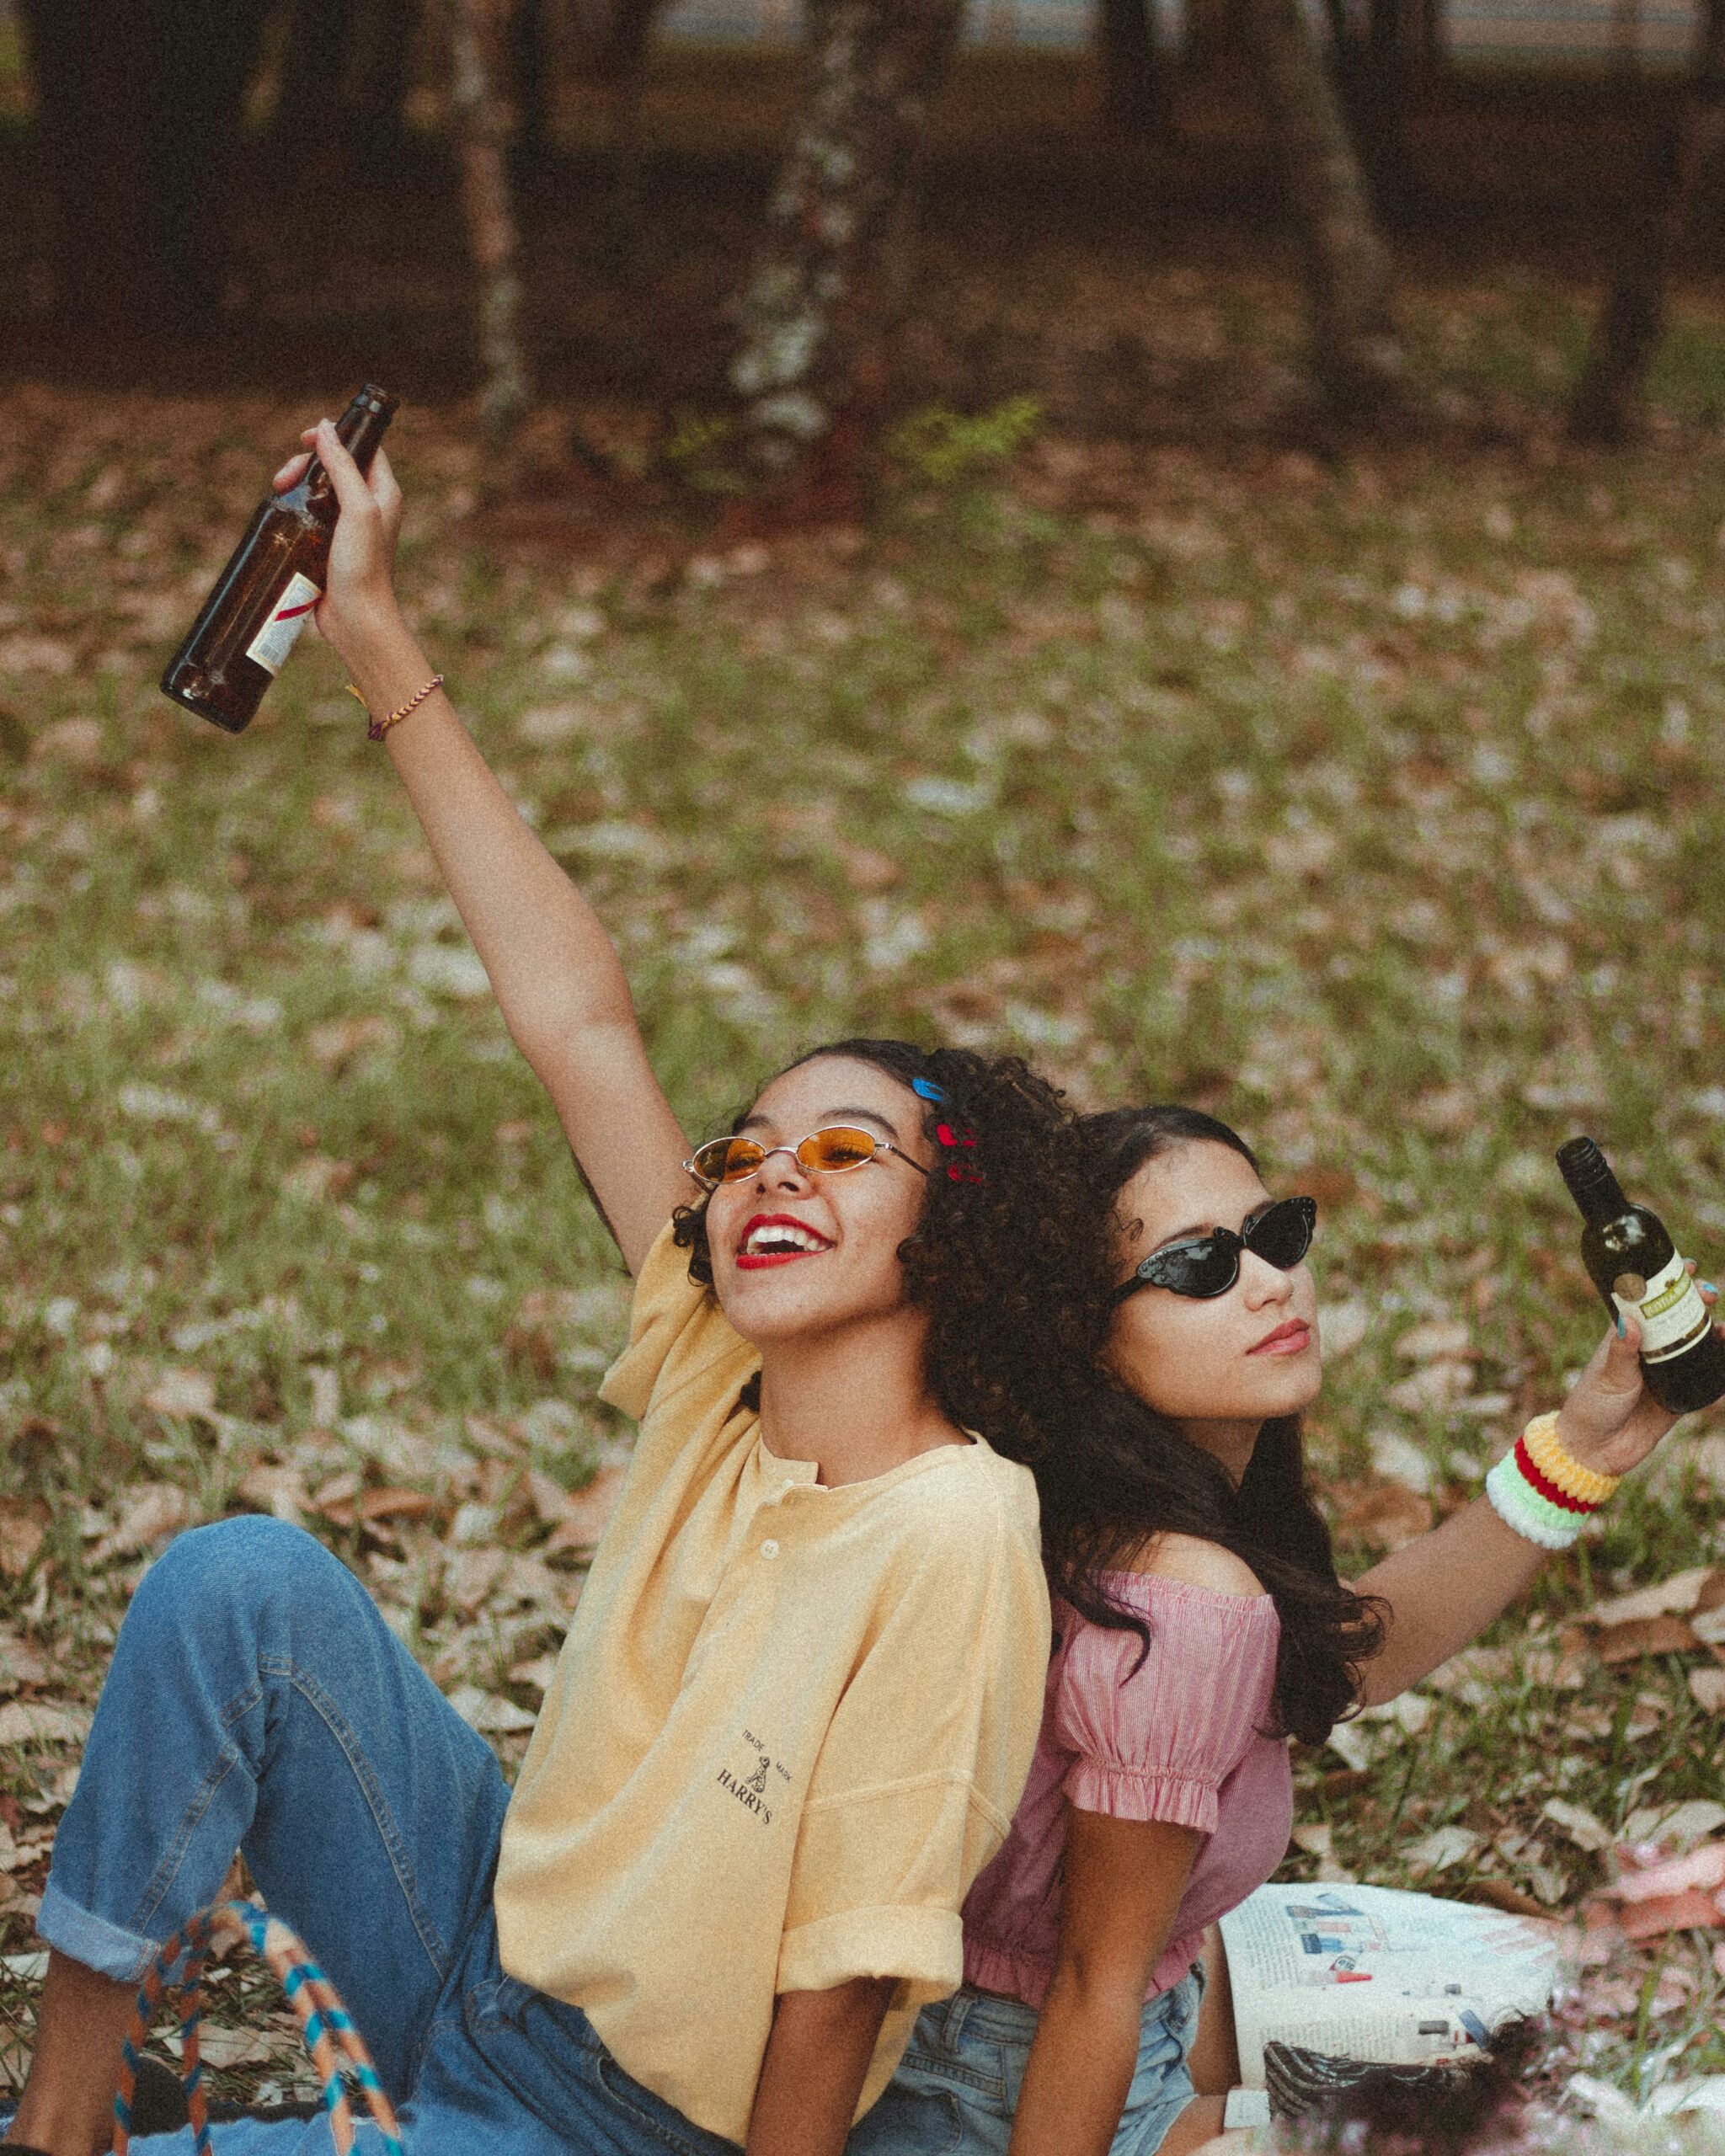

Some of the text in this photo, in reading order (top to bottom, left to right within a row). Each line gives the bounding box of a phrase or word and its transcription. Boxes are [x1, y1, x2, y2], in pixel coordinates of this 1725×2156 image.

[742, 1729, 793, 1783] TRADE MARK
[717, 1769, 772, 1824] HARRY'S
